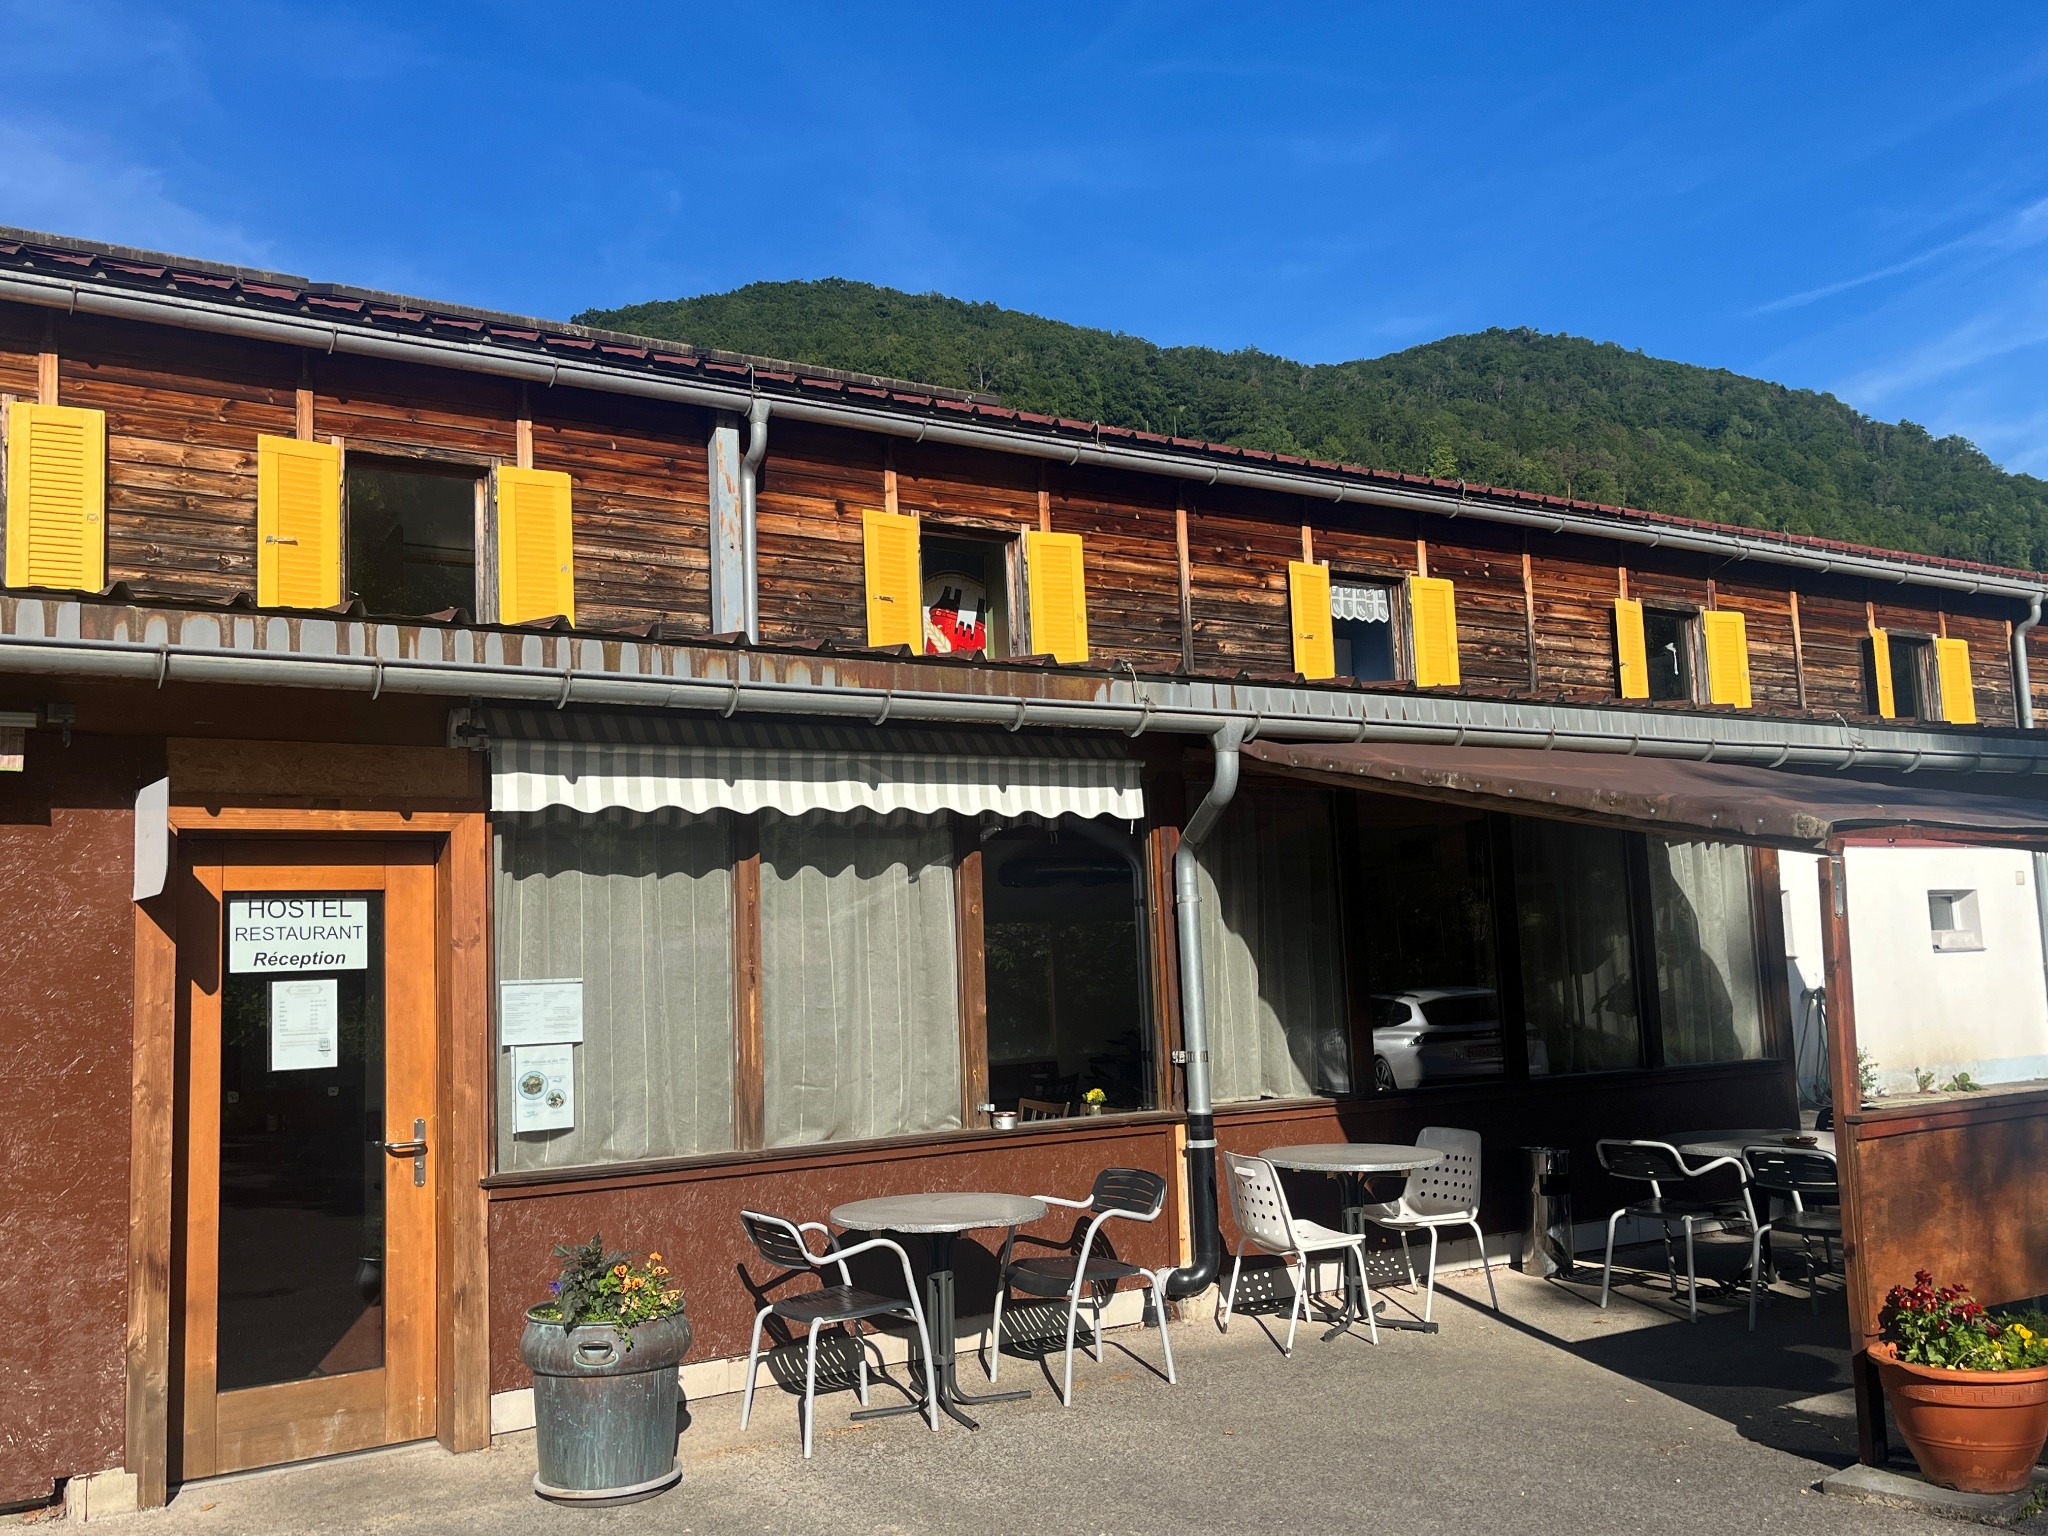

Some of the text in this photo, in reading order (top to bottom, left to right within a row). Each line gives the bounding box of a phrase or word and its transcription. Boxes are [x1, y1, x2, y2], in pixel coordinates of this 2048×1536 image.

[248, 899, 353, 919] HOSTEL
[235, 925, 363, 942] RESTAURANT
[253, 951, 346, 969] Réception
